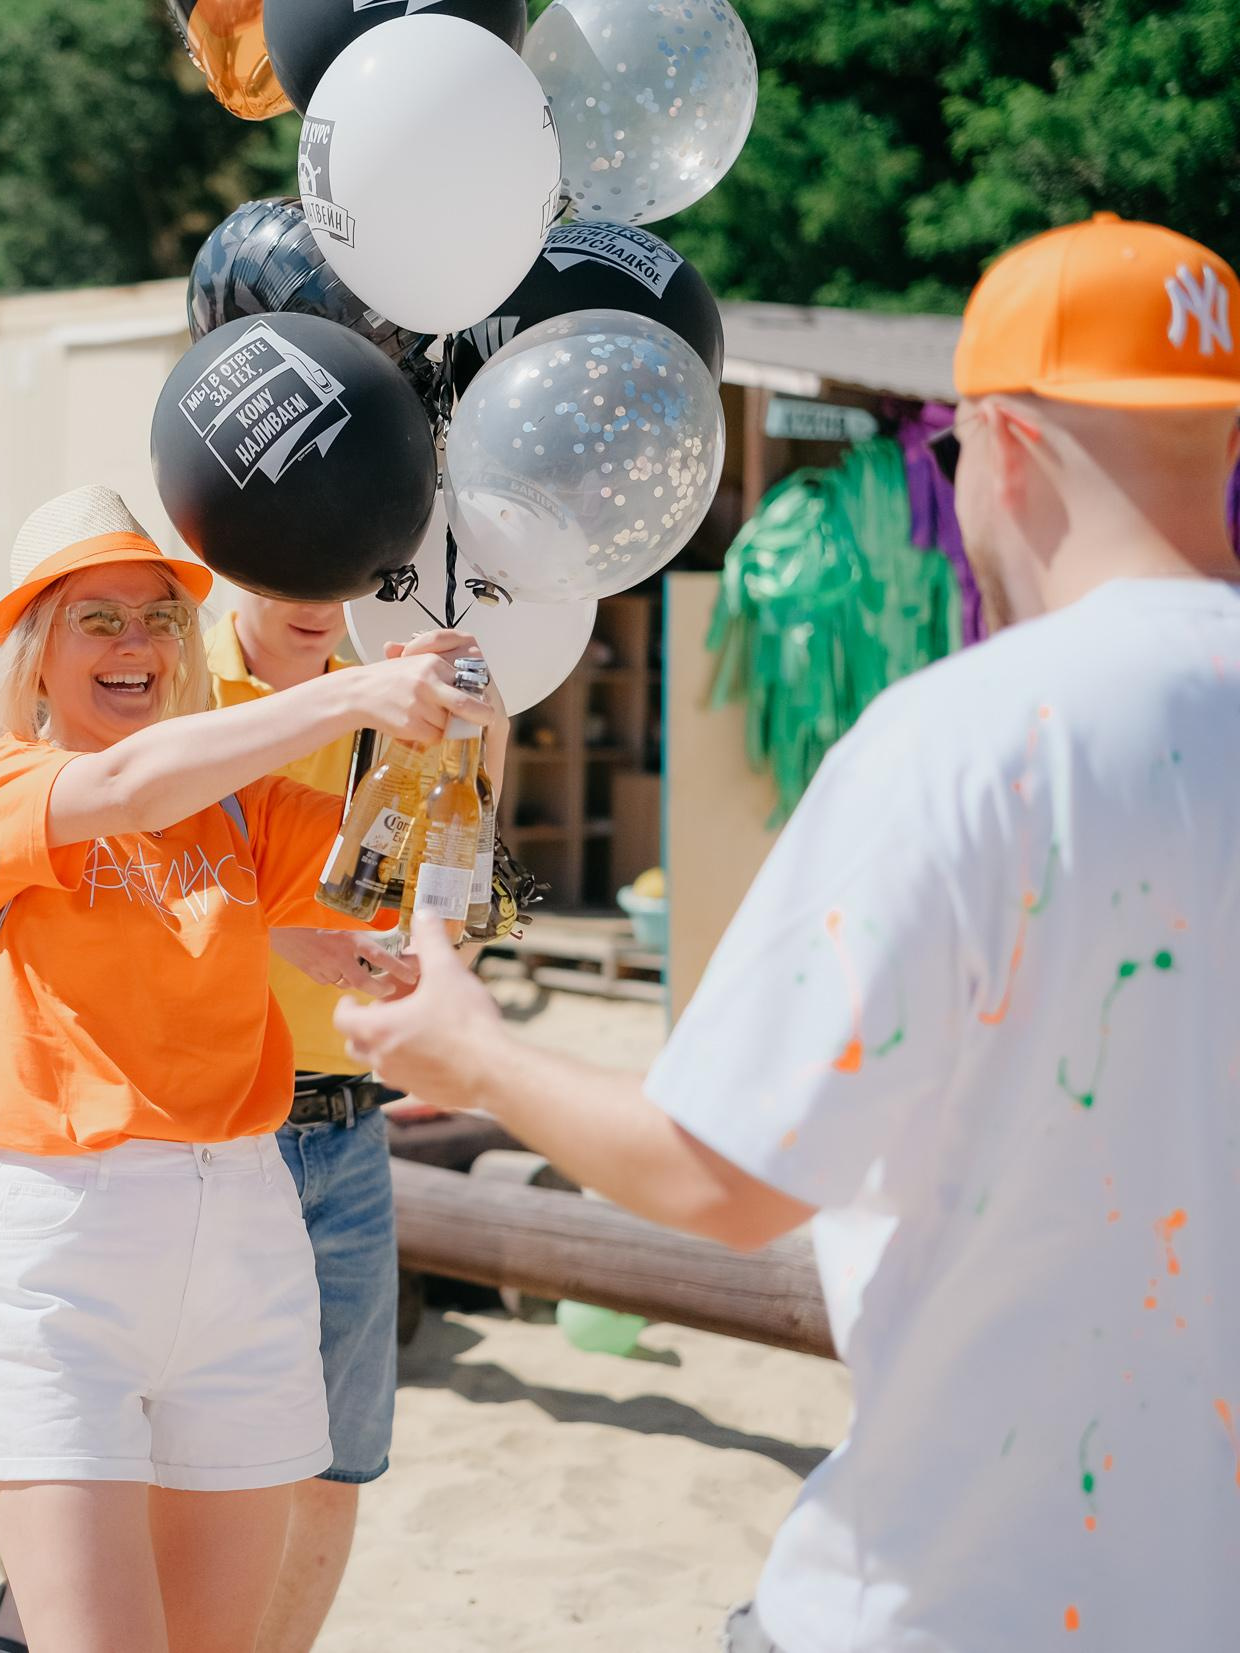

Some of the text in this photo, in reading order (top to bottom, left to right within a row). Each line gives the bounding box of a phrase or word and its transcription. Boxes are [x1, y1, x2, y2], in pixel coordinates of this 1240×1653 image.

[1164, 264, 1234, 356] NY
[186, 340, 268, 412] МЫ В ОТВЕТЕ
[209, 363, 263, 407] ЗА ТЕХ,
[235, 388, 274, 429] КОМУ
[235, 393, 309, 467] НАЛИВАЕМ
